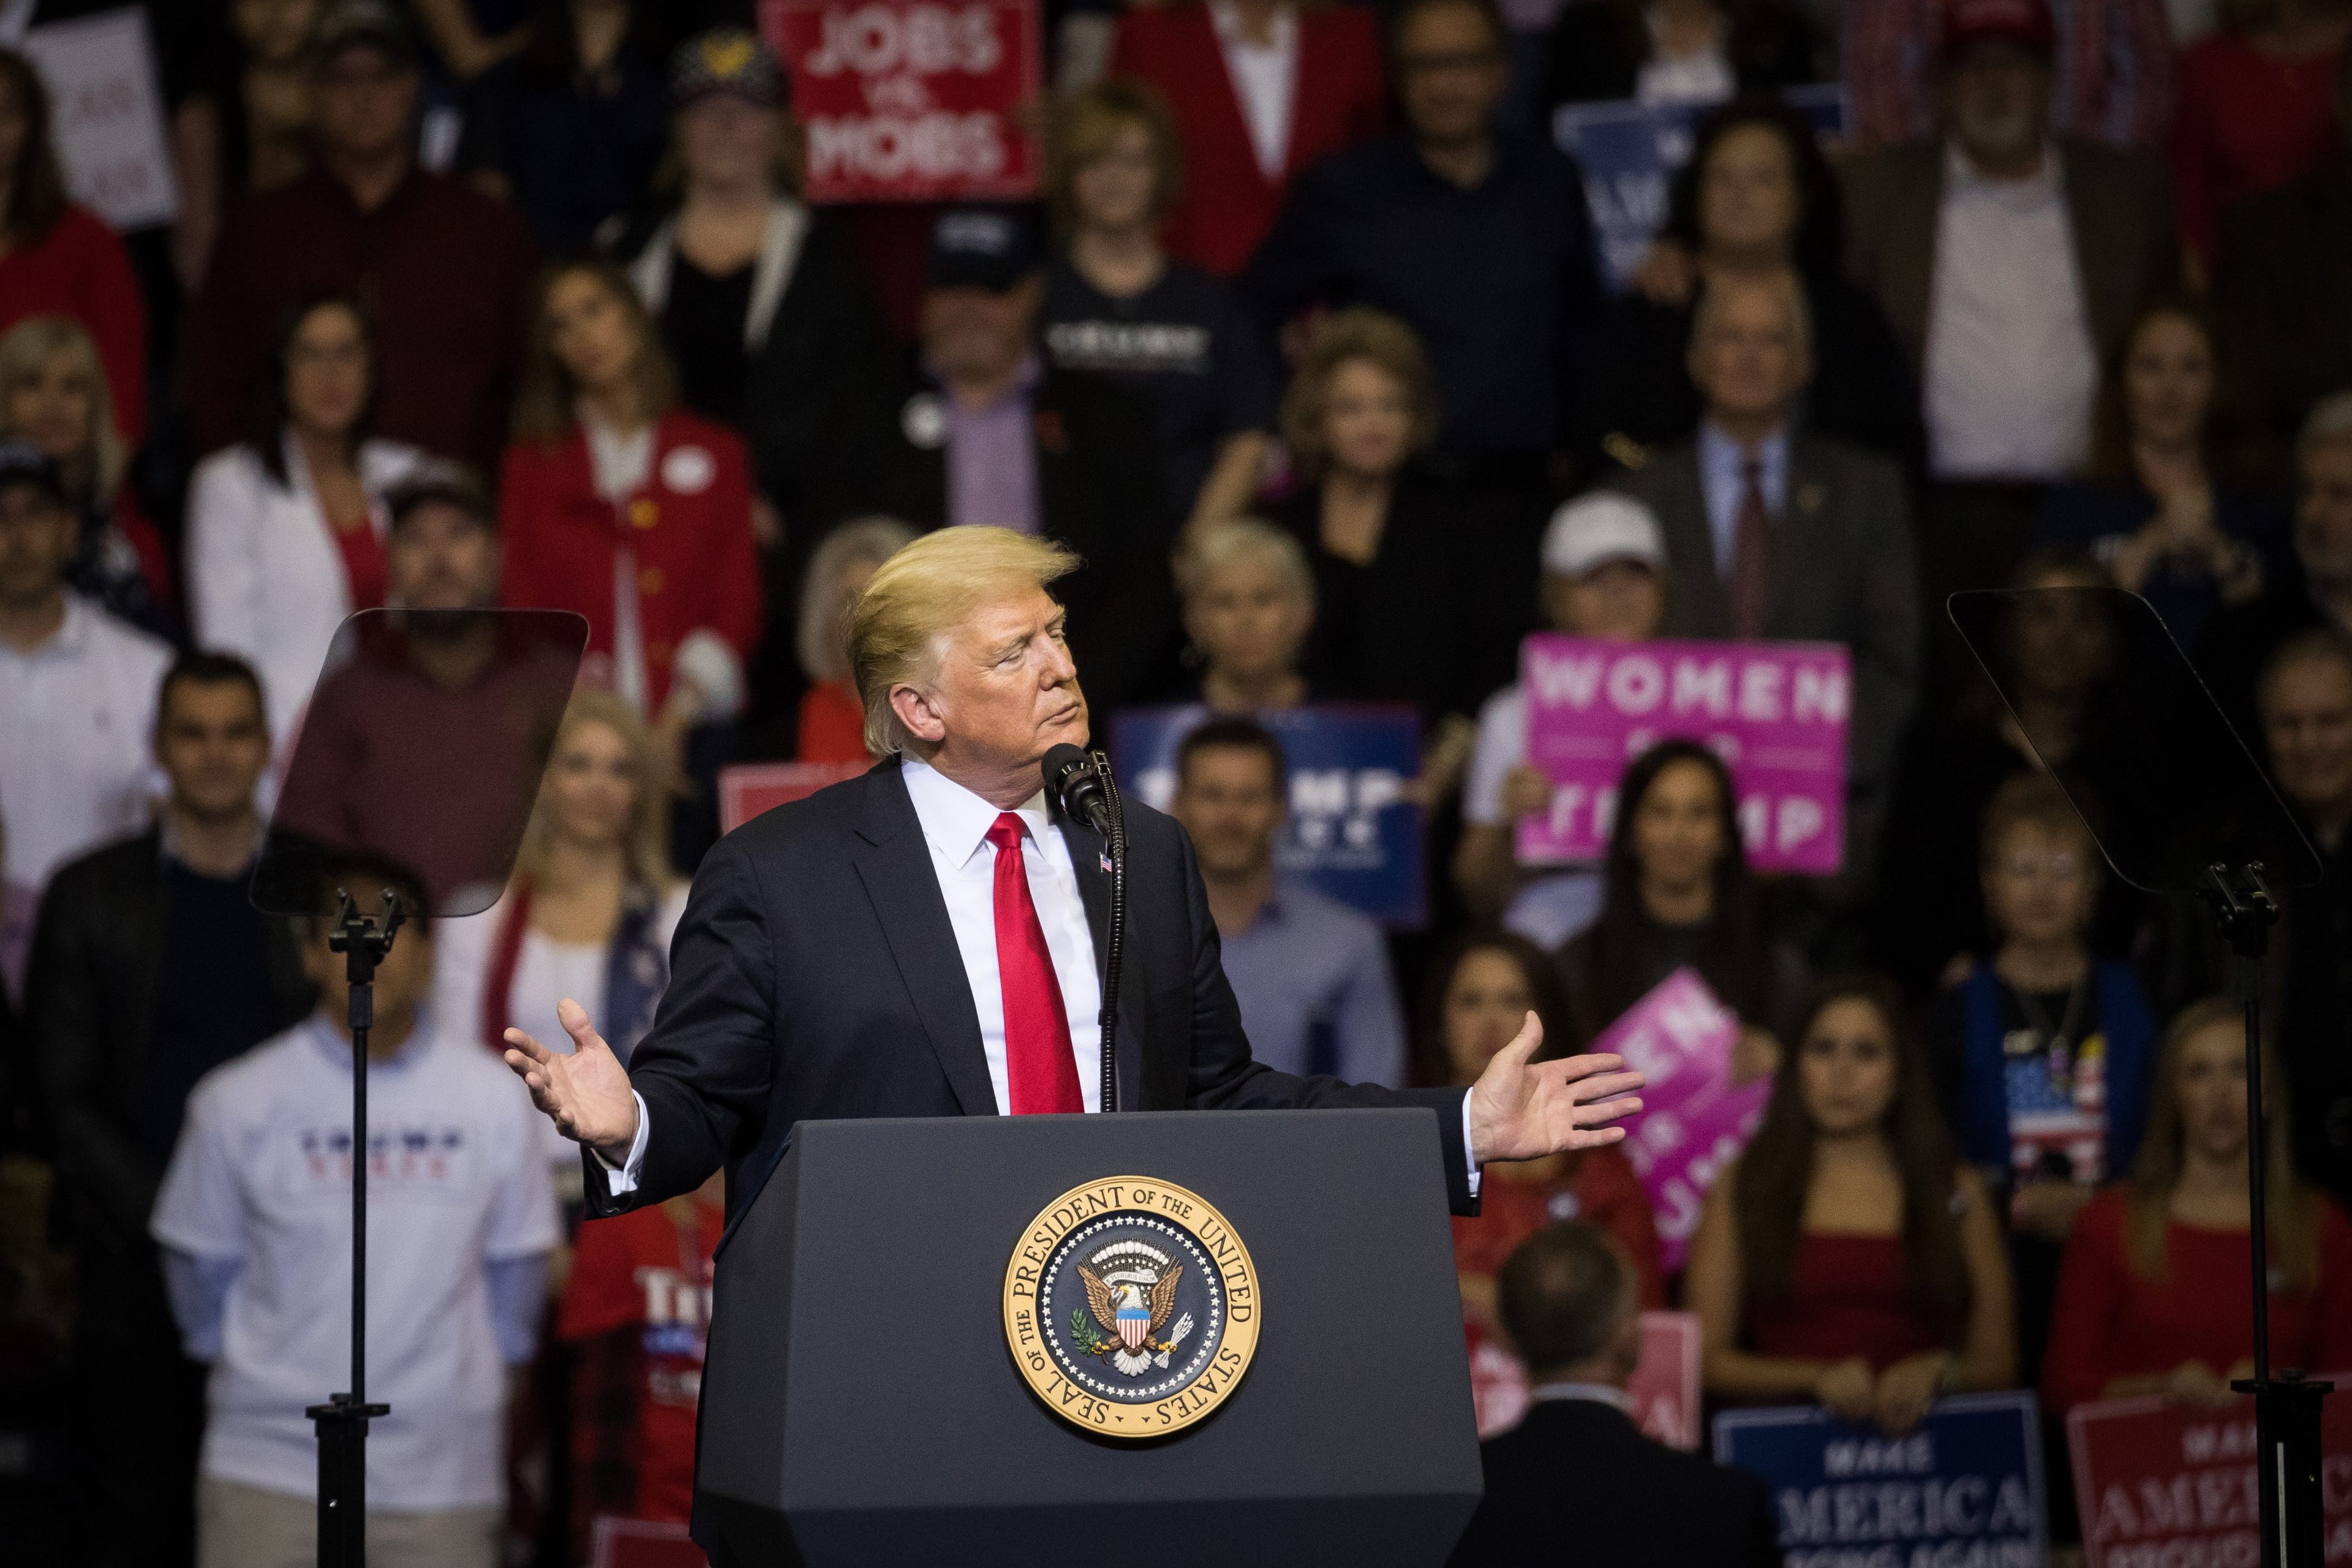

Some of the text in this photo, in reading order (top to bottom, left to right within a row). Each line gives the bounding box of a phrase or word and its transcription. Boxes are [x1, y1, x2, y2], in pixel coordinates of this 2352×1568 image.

[805, 3, 1002, 77] JOBS
[807, 111, 1007, 178] MOBS
[1526, 650, 1851, 723] WOMEN
[1014, 1186, 1251, 1425] SEAL OF THE PRESIDENT OF THE UNITED STATES
[1823, 1431, 1934, 1477] MAKE
[1777, 1475, 2032, 1544] MERICA
